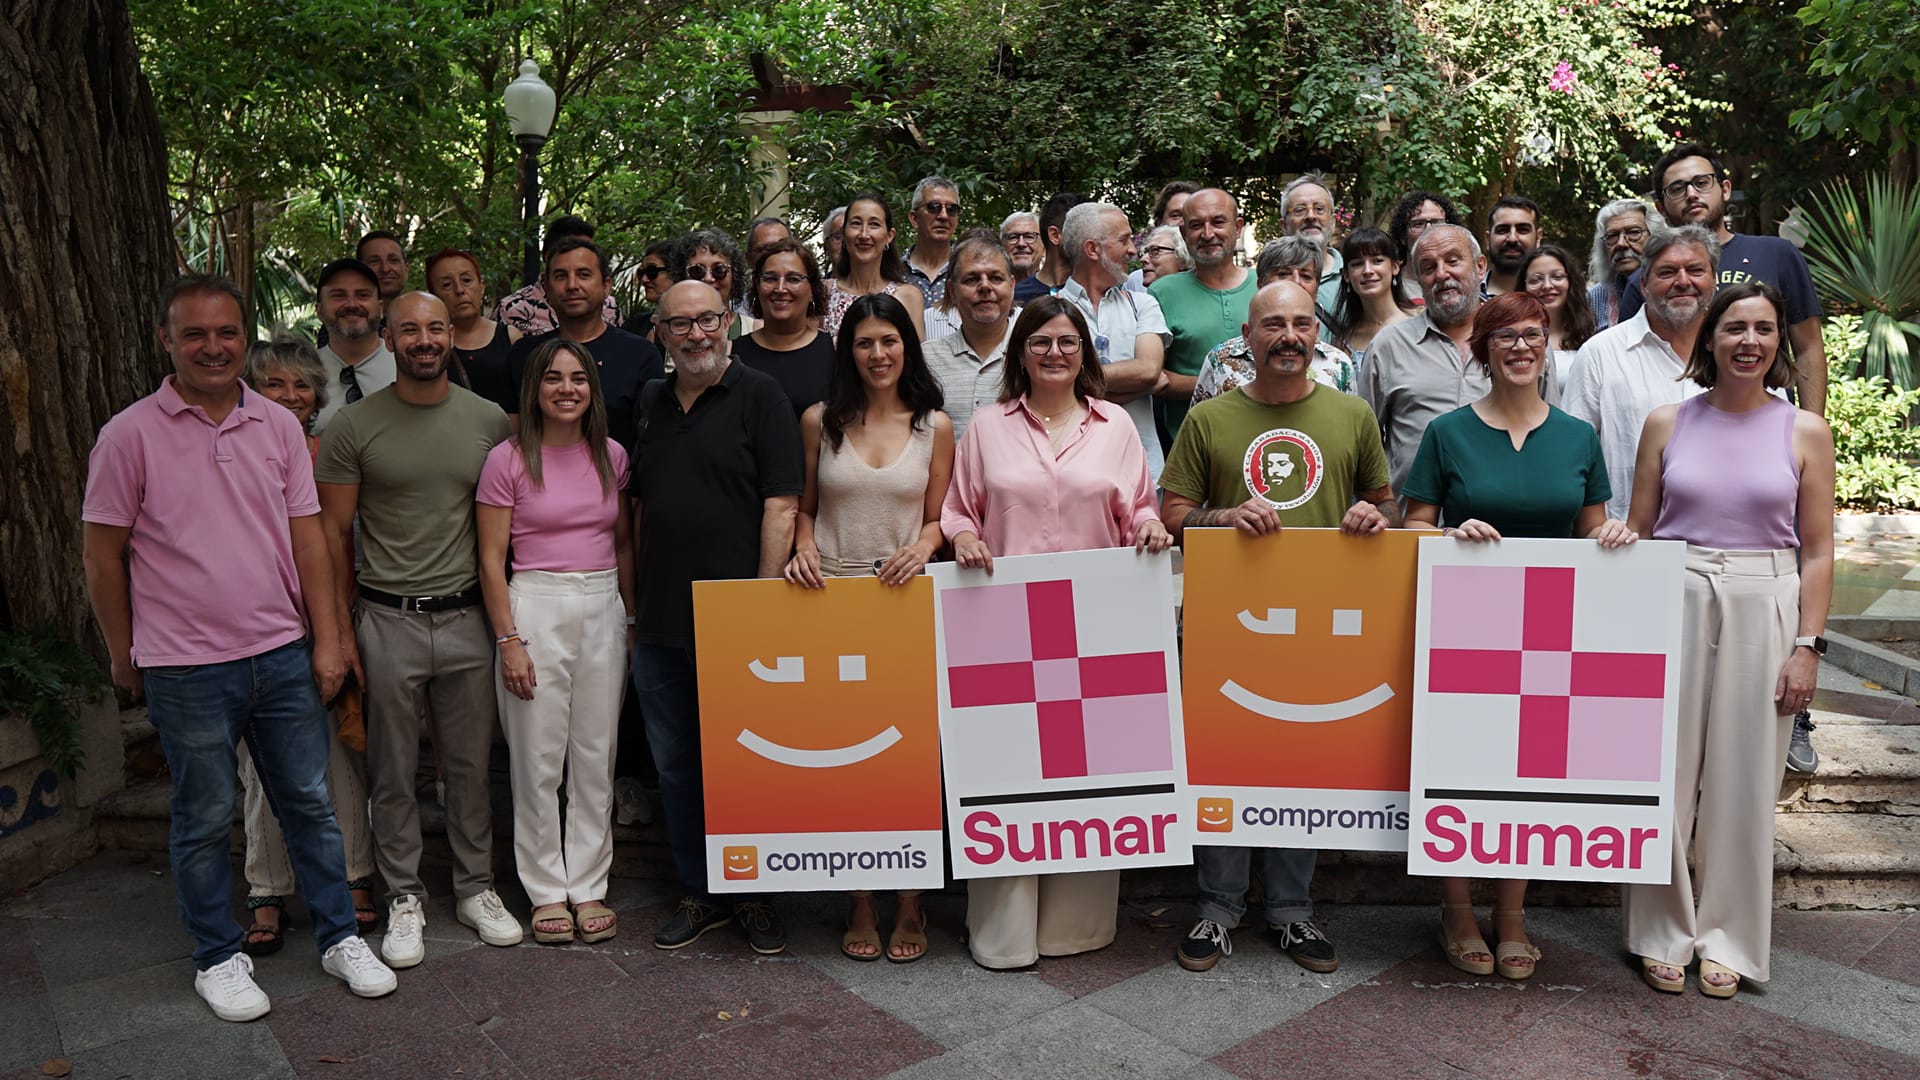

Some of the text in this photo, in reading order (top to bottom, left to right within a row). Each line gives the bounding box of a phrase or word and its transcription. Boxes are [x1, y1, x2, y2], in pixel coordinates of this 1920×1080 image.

[963, 811, 1178, 865] Sumar
[1242, 803, 1409, 835] compromís
[1422, 804, 1658, 869] Sumar
[766, 843, 927, 878] compromís
